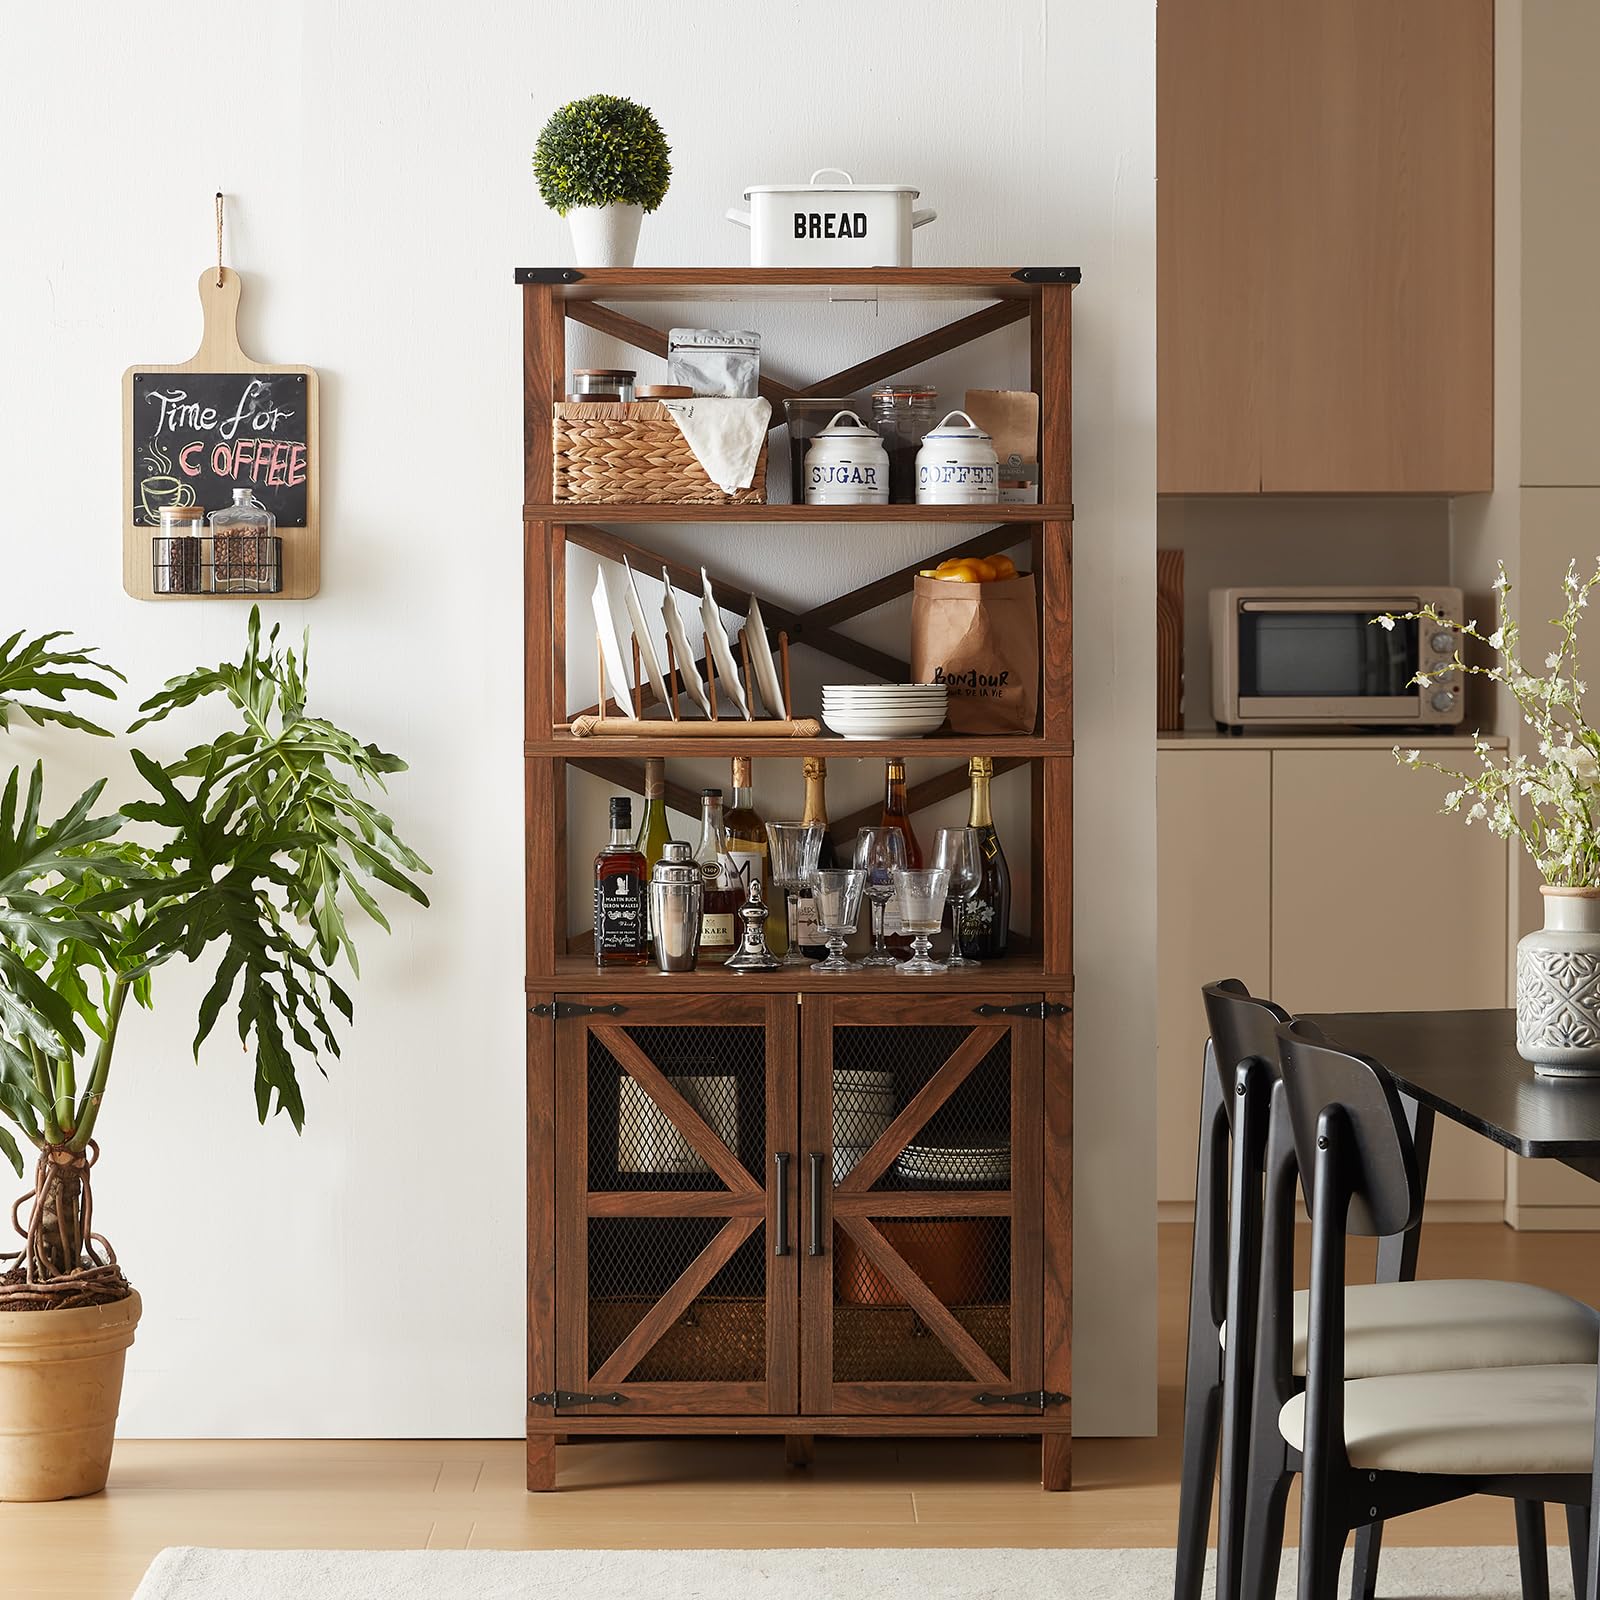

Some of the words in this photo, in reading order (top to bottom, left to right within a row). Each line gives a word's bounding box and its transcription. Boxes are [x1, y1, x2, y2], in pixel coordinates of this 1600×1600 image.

[794, 213, 867, 238] BREAD
[146, 389, 218, 437] Time
[219, 379, 295, 440] for
[179, 438, 307, 488] COFFEE
[812, 466, 876, 485] SUGAR
[920, 466, 994, 484] COFFEE
